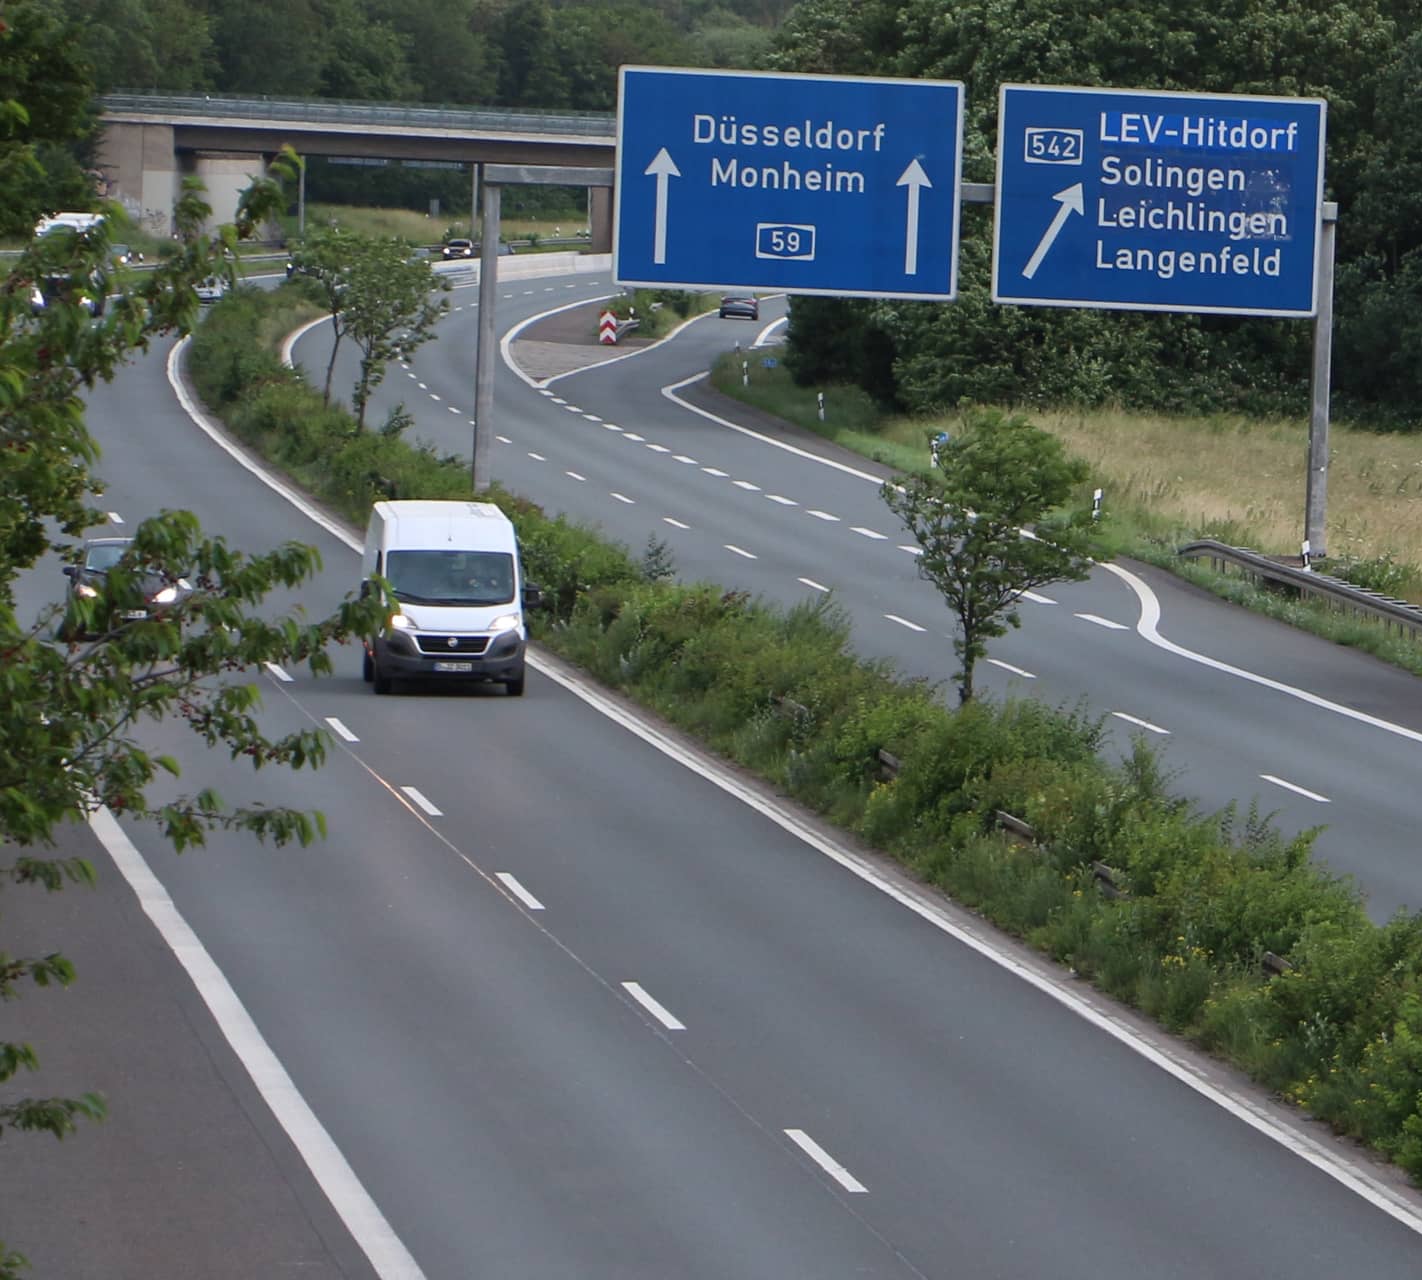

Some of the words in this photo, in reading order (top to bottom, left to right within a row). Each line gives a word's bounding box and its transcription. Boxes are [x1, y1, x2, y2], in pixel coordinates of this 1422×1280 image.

[694, 114, 885, 152] Düsseldorf
[1032, 136, 1076, 158] 542
[1100, 112, 1298, 151] LEV-Hitdorf
[711, 158, 865, 193] Monheim
[1100, 156, 1245, 197] Solingen
[1097, 198, 1287, 240] Leichlingen
[770, 230, 800, 253] 59
[1096, 240, 1282, 279] Langenfeld
